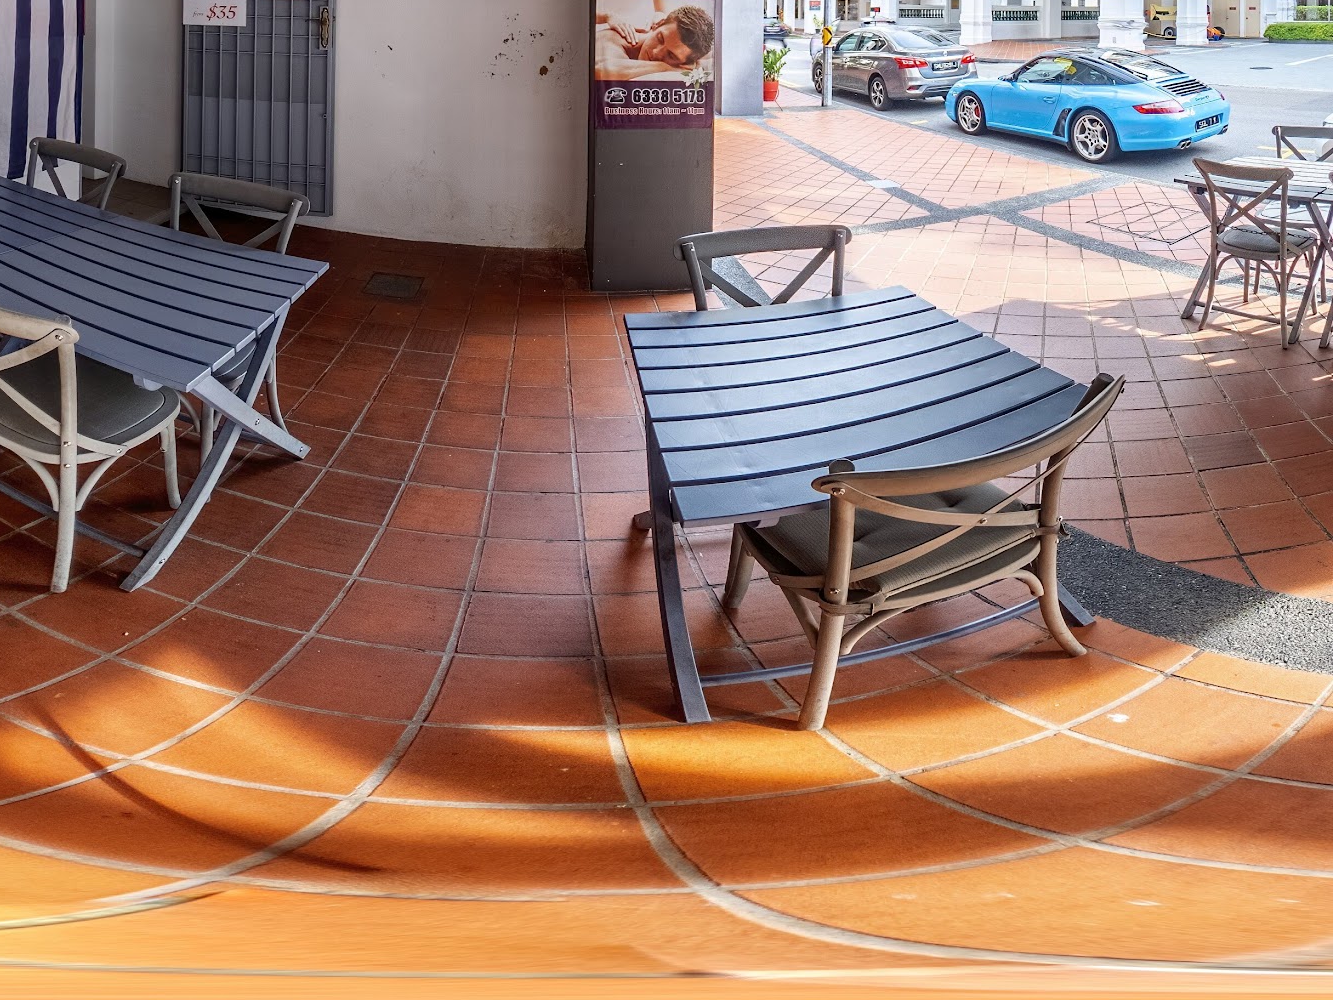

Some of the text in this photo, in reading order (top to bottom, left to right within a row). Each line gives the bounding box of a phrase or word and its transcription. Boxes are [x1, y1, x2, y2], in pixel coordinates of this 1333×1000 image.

[206, 3, 238, 21] $35
[632, 88, 705, 104] 6338 5178
[605, 106, 638, 115] Business
[639, 106, 662, 115] Hours:
